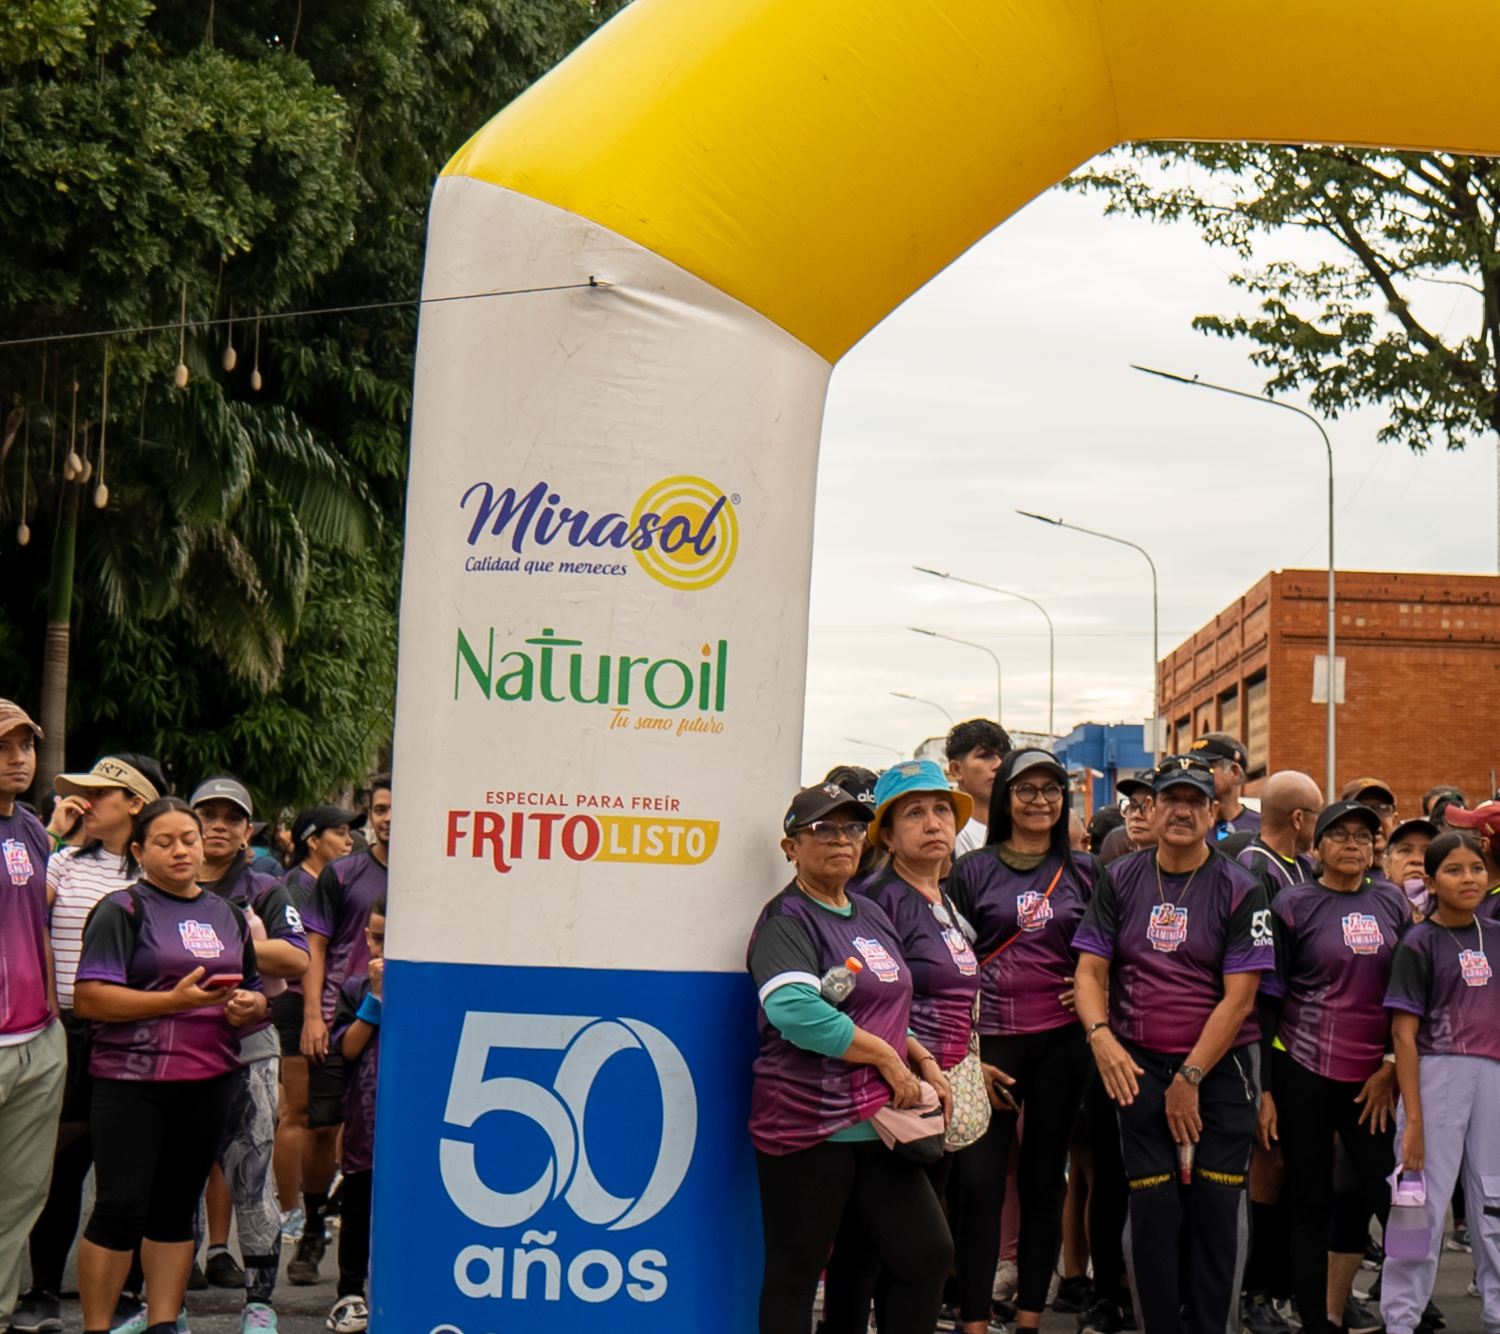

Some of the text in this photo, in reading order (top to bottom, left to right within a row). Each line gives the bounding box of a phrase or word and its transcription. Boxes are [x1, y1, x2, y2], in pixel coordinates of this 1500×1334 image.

[459, 481, 728, 556] Mirasol
[464, 556, 628, 576] Calidad que mereces
[454, 626, 728, 713] Naturoil
[610, 708, 725, 737] Tu sano futuro
[485, 791, 680, 812] ESPECIAL PARA FREÍR
[446, 810, 706, 874] FRITO LISTO
[1250, 909, 1274, 939] 50
[1253, 936, 1275, 947] año
[439, 1010, 699, 1231] 50
[453, 1229, 668, 1303] años
